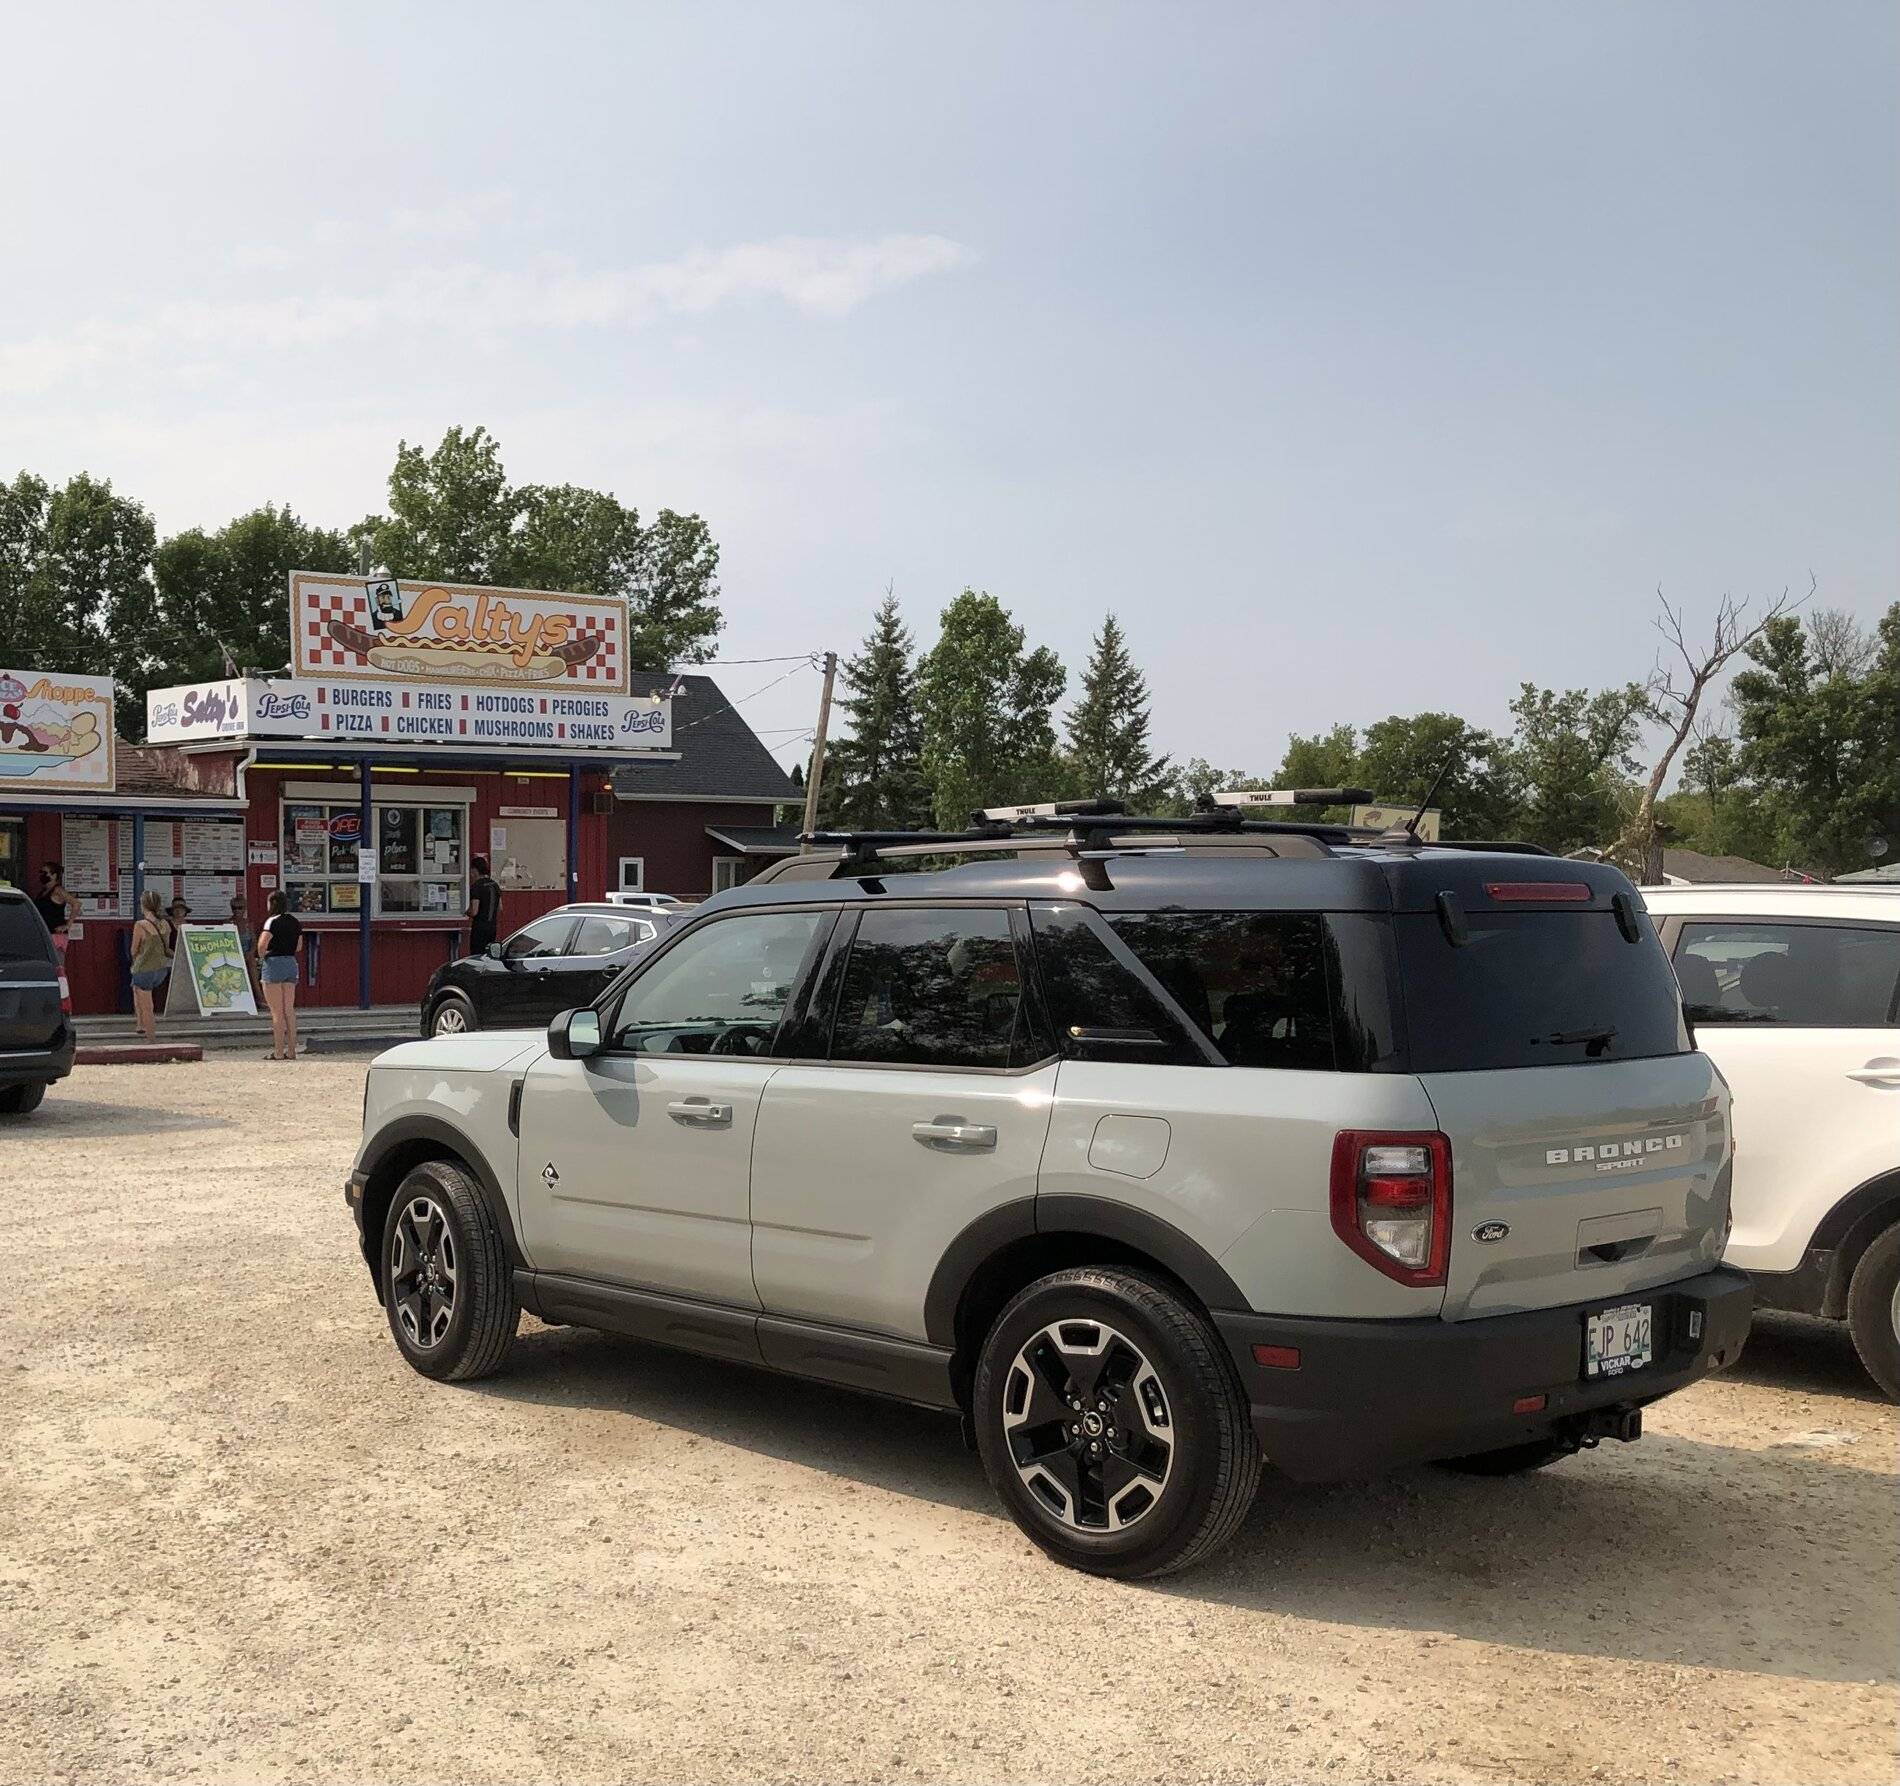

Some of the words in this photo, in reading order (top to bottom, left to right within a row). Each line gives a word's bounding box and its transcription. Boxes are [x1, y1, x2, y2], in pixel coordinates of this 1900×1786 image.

[384, 588, 571, 667] Saltys
[26, 678, 96, 706] Shoppe
[333, 689, 392, 708] BURGERS
[418, 693, 452, 711] FRIES
[476, 695, 534, 714] HOTDOGS
[553, 699, 609, 717] PEROGIES
[336, 714, 373, 732] PIZZA
[397, 716, 453, 735] CHICKEN
[474, 719, 554, 738] MUSHROOMS
[570, 723, 615, 741] SHAKES
[1249, 794, 1273, 802] THULE
[1016, 808, 1036, 816] THULE
[191, 938, 235, 953] LEMONADE
[1546, 1135, 1682, 1164] BRONCO
[1596, 1158, 1645, 1171] SPORT
[1481, 1226, 1505, 1239] Ford
[1624, 1319, 1650, 1352] 642
[1600, 1355, 1631, 1371] VICKAR
